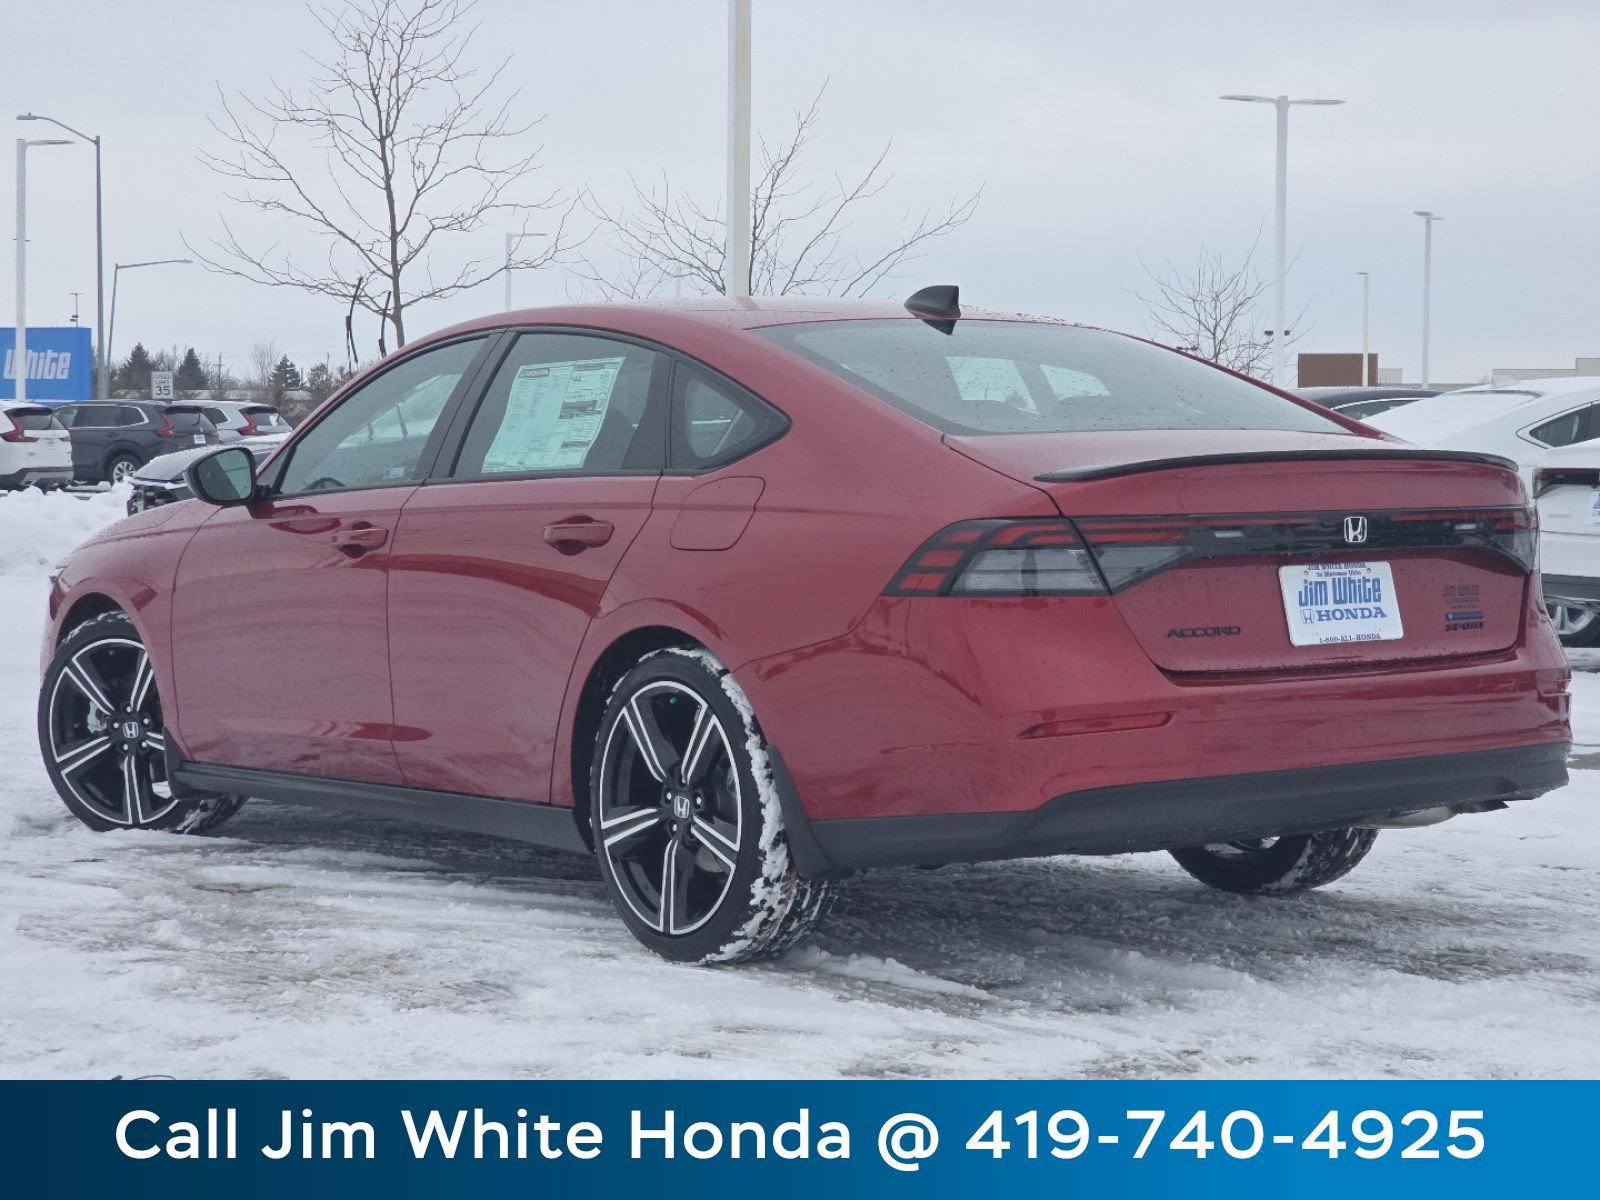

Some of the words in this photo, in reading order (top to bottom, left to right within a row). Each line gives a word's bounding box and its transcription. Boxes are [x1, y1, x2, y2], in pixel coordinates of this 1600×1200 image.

[155, 385, 171, 396] 35
[1298, 579, 1328, 607] Jim
[1332, 577, 1382, 605] White
[1317, 607, 1388, 622] HONDA
[1167, 625, 1241, 638] ACCORD
[1445, 621, 1487, 632] SPORT
[1319, 633, 1382, 644] 1-800-ALL-HONDA
